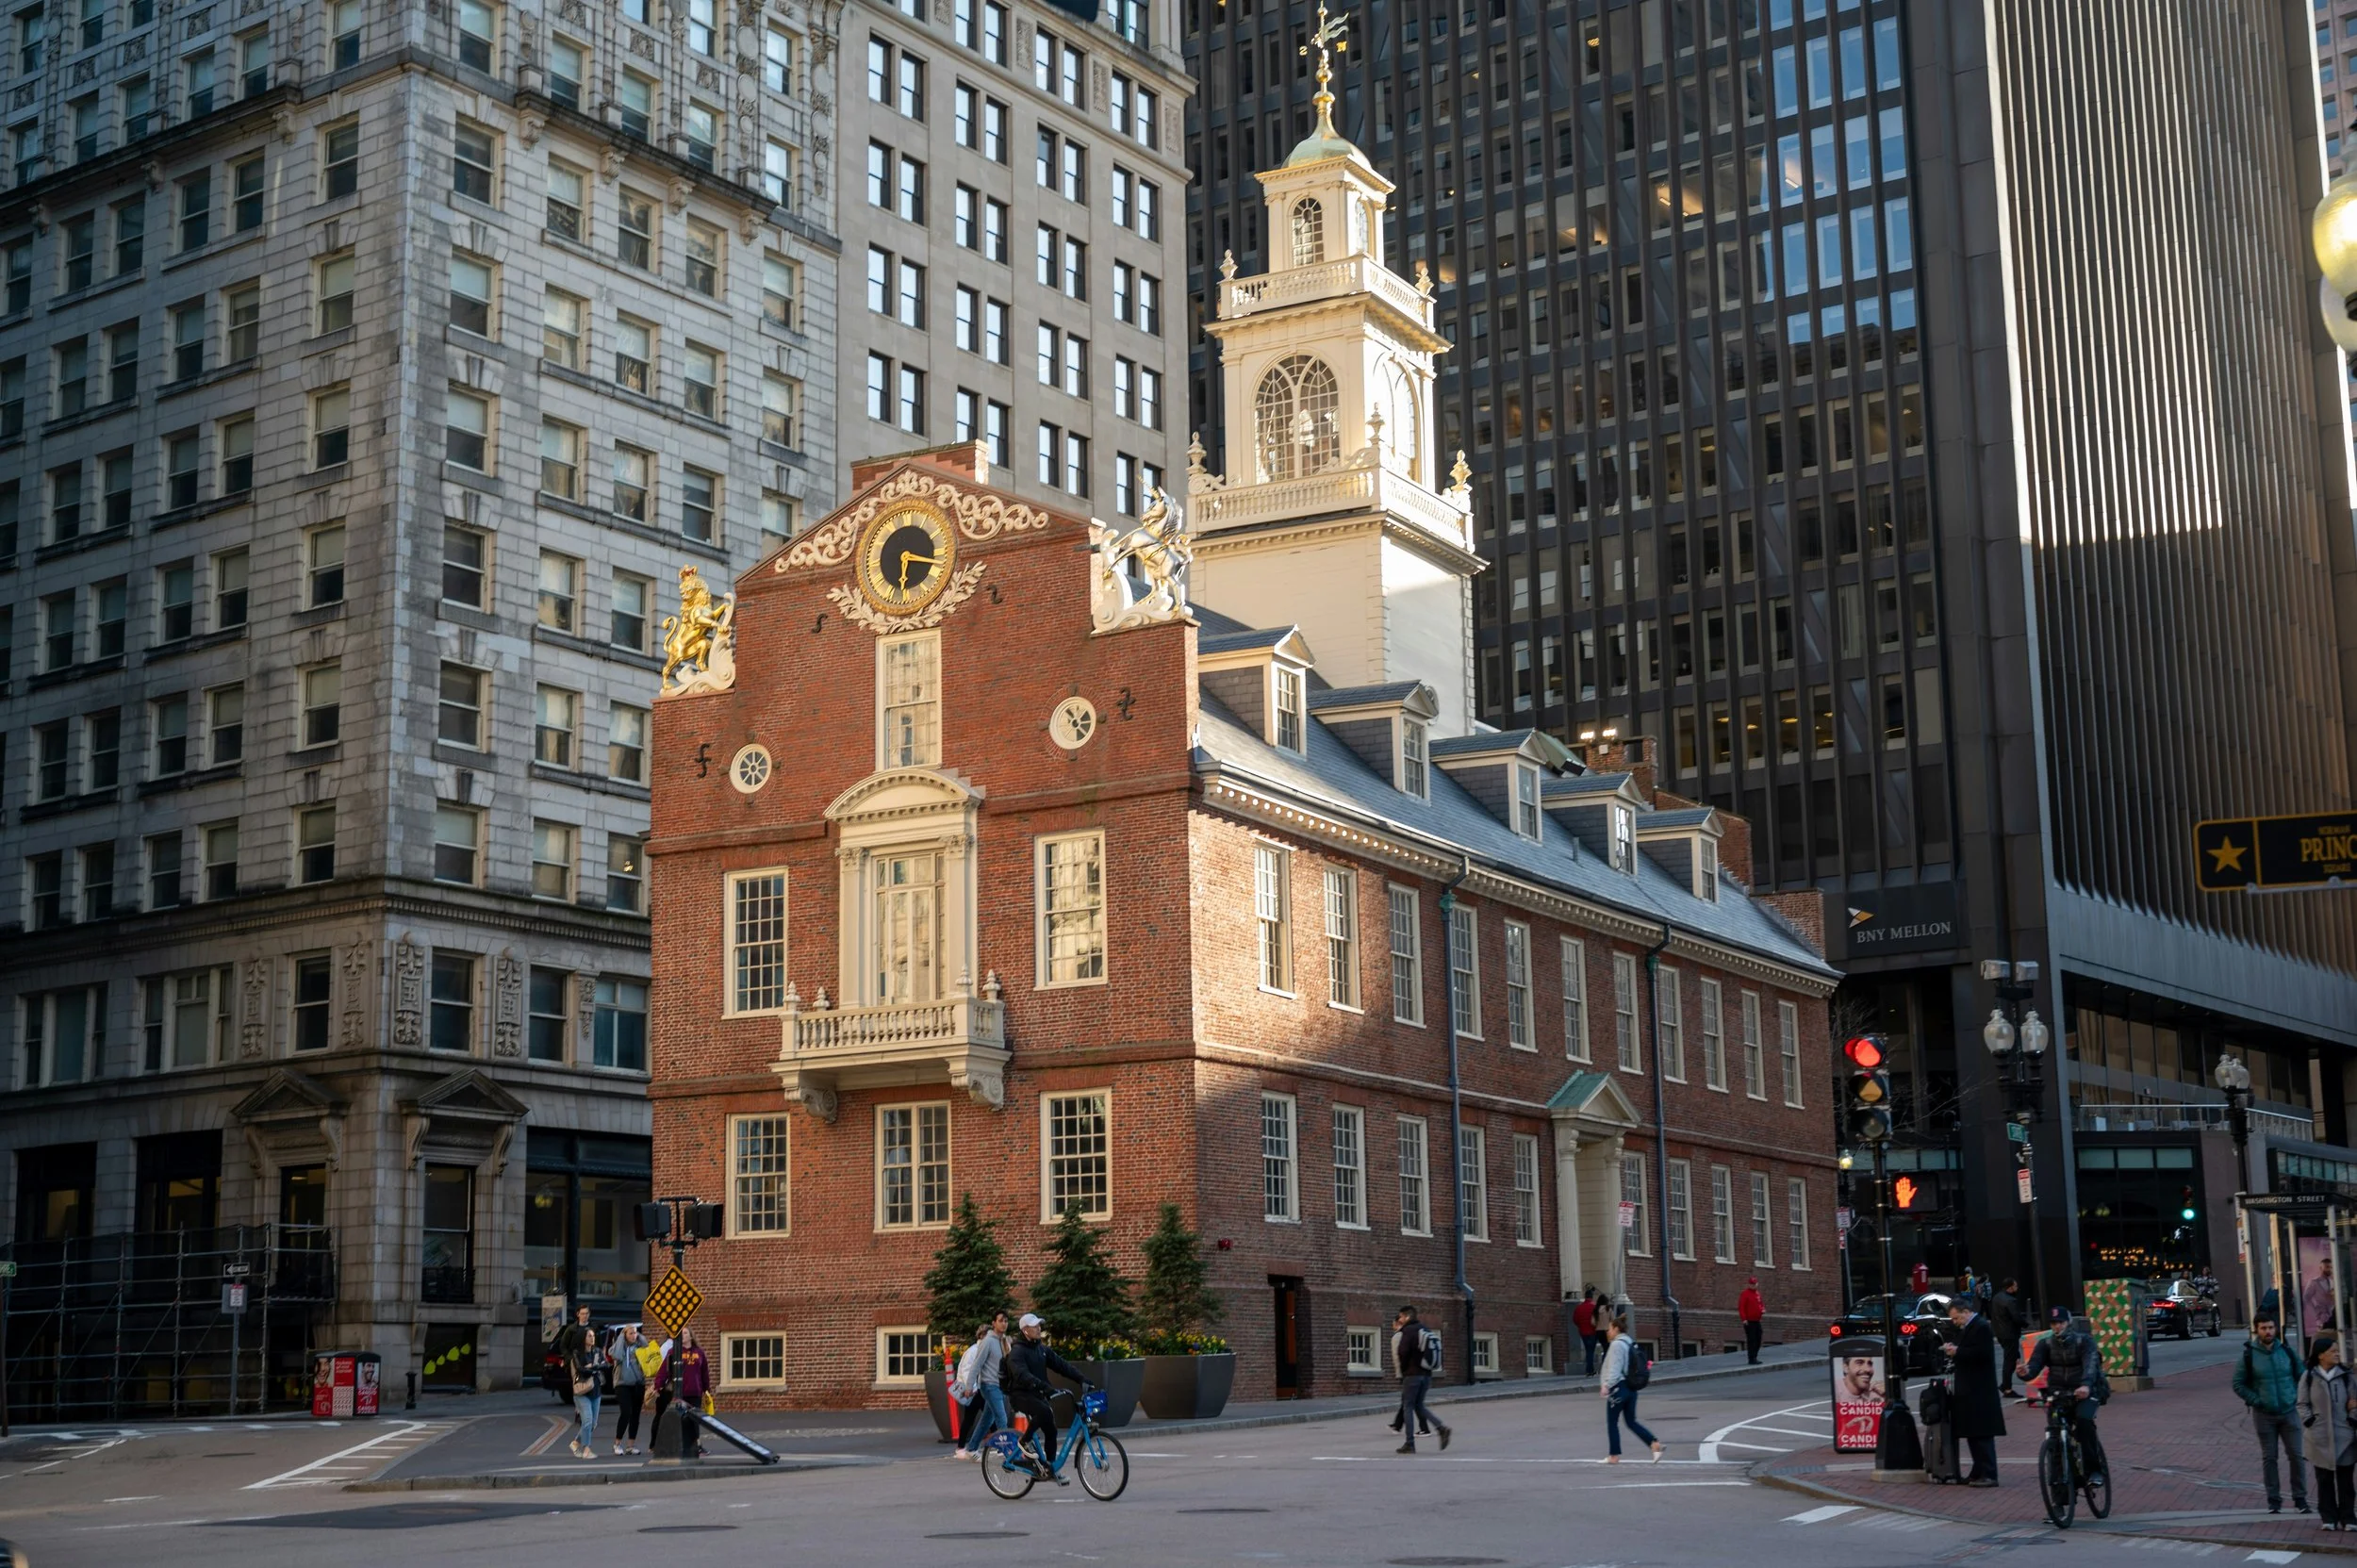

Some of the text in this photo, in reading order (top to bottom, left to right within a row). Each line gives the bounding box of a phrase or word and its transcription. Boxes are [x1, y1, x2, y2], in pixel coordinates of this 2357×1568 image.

[1856, 921, 1952, 944] BNY MELLON
[2245, 1195, 2325, 1205] WASHINGTON STREET
[1839, 1407, 1883, 1415] CANDID
